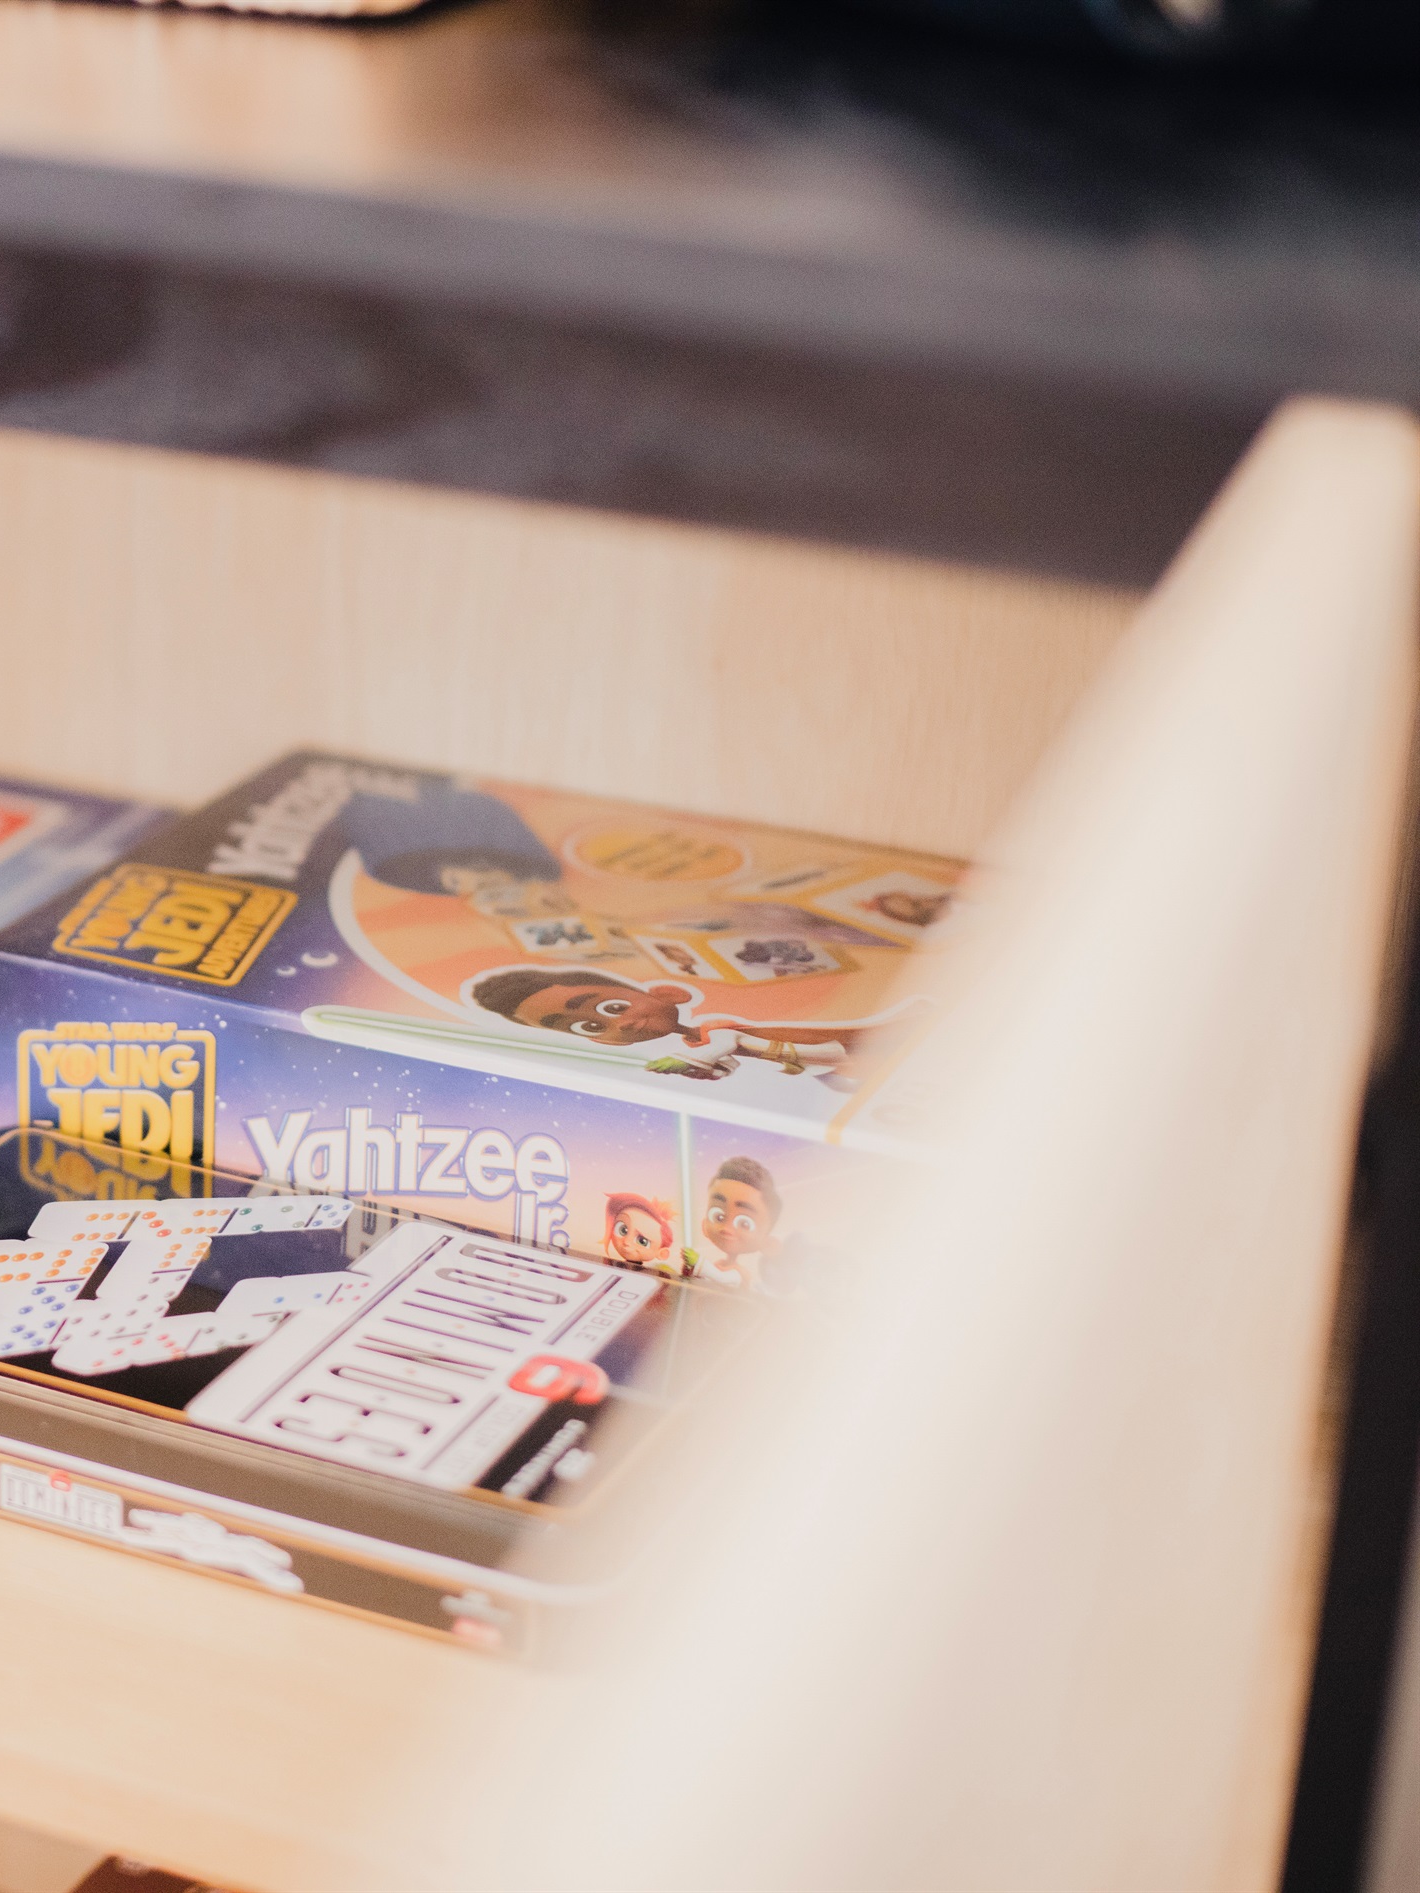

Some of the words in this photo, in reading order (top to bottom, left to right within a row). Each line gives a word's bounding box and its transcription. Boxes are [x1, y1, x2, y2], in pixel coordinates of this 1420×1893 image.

[70, 872, 170, 950] YOUNG
[124, 881, 248, 967] JEDI
[30, 1043, 201, 1089] YOUNG
[33, 1088, 195, 1157] JEDI
[243, 1105, 570, 1204] Yahtzee
[272, 1241, 596, 1459] DOMINOES
[575, 1289, 641, 1343] DOUBLE
[507, 1354, 612, 1406] 6
